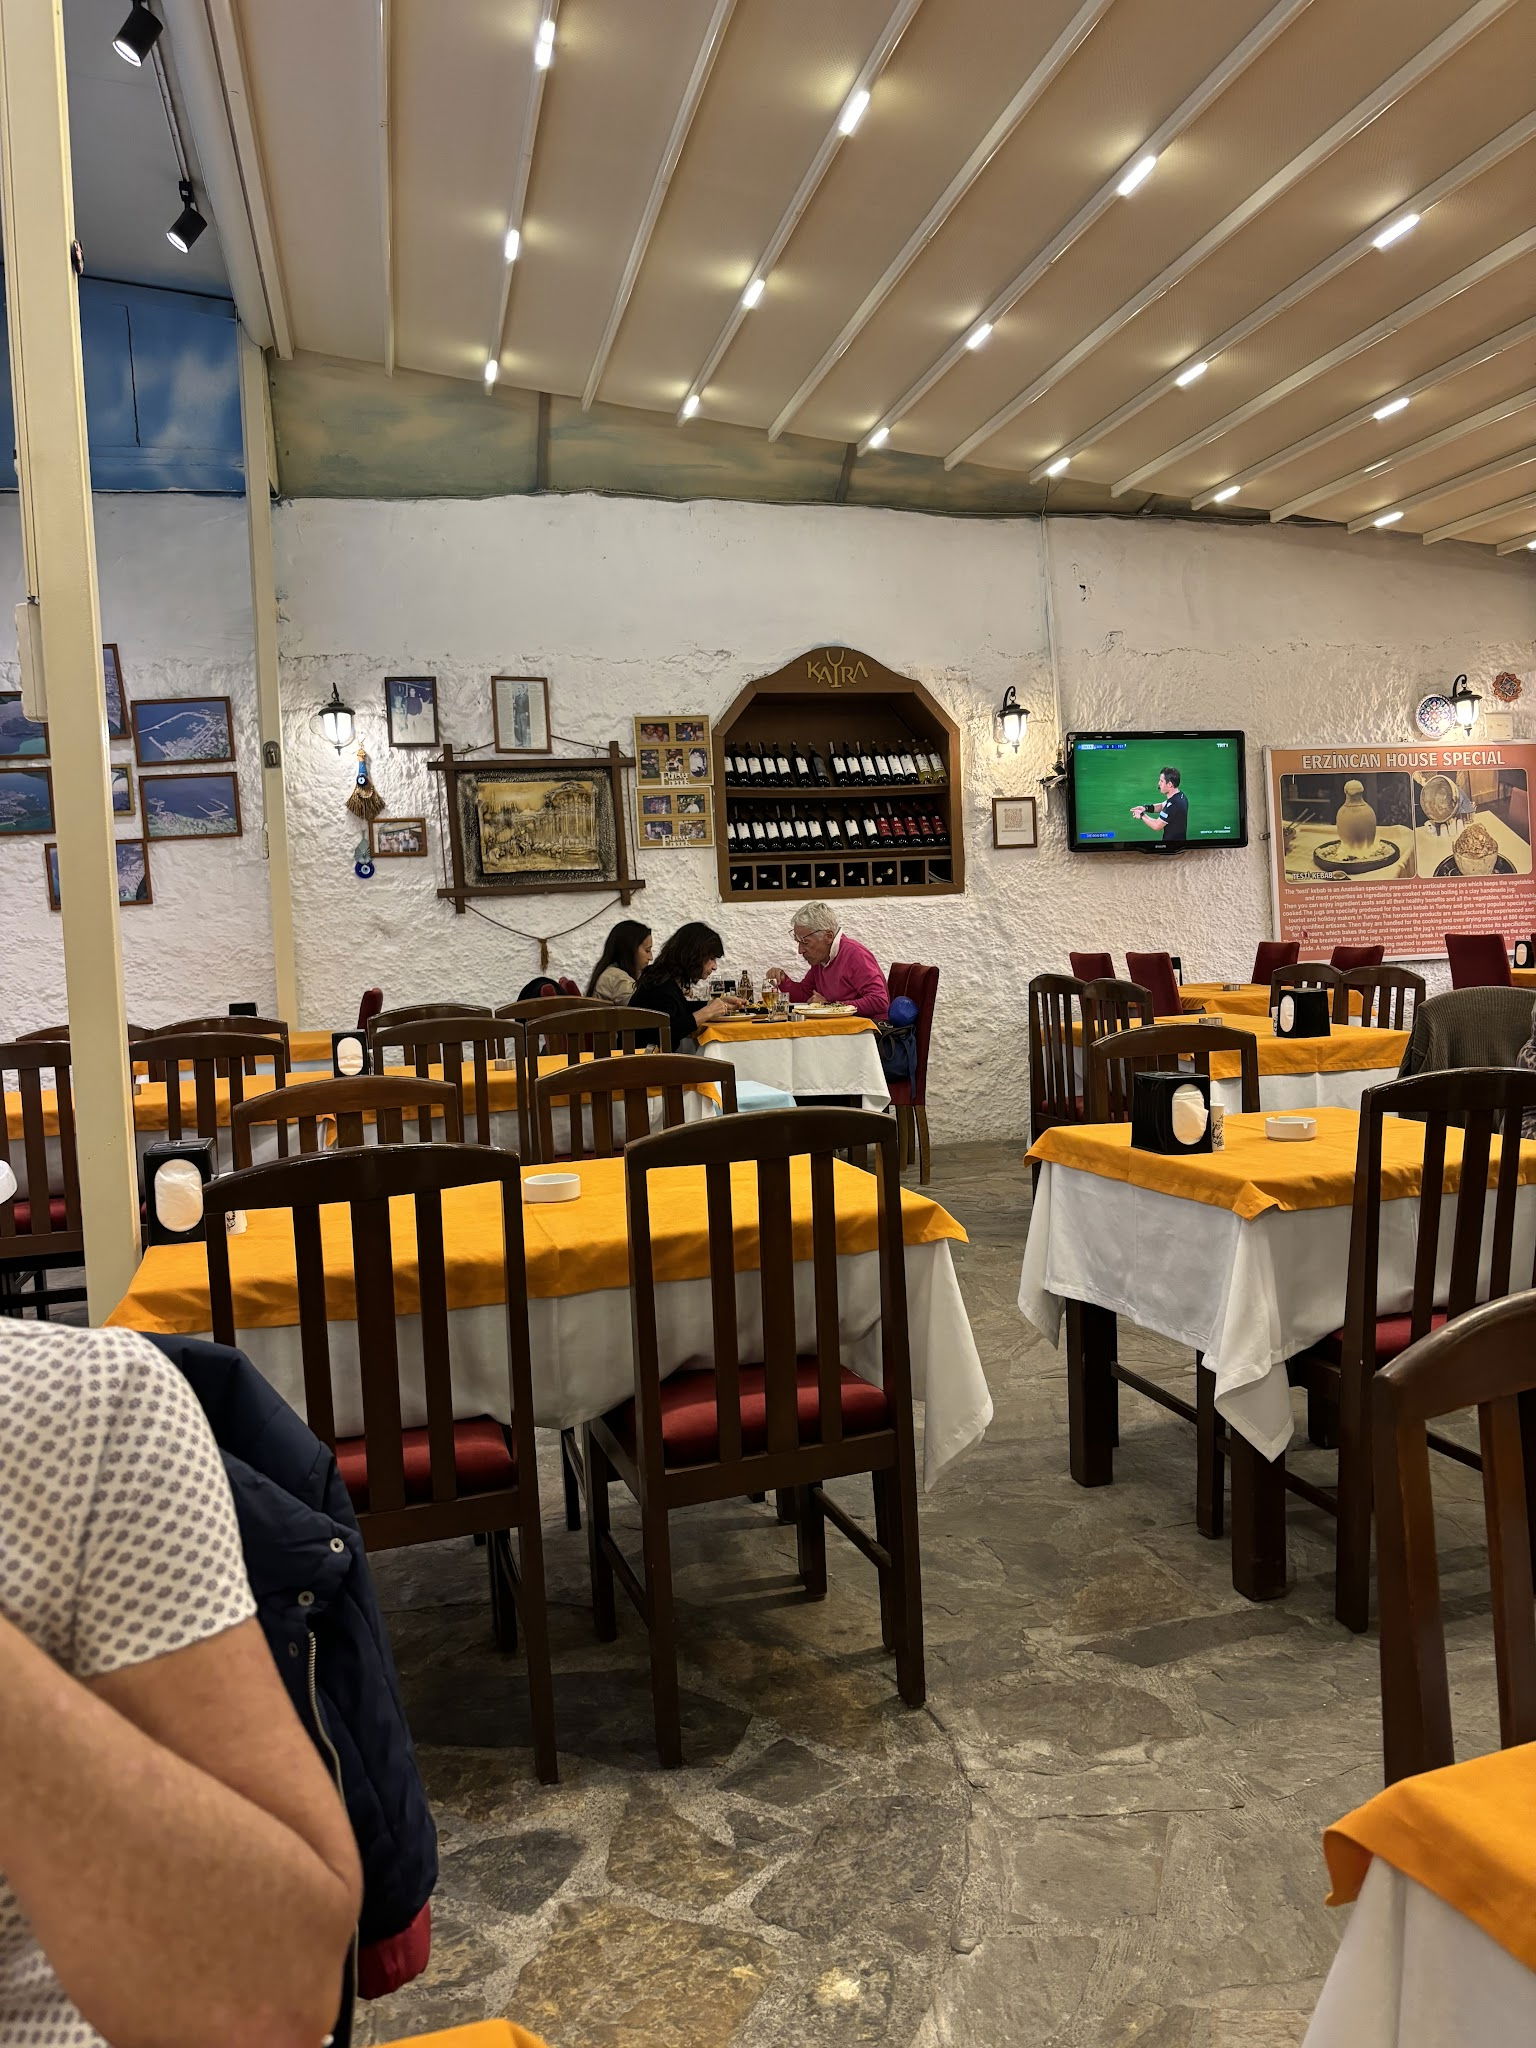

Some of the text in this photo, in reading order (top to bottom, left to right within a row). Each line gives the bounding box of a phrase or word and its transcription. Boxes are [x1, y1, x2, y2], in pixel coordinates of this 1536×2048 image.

[806, 650, 869, 688] KAYRA
[1302, 751, 1506, 770] ERZİNCAN HOUSE SPECIAL
[1311, 871, 1333, 880] KEBAB
